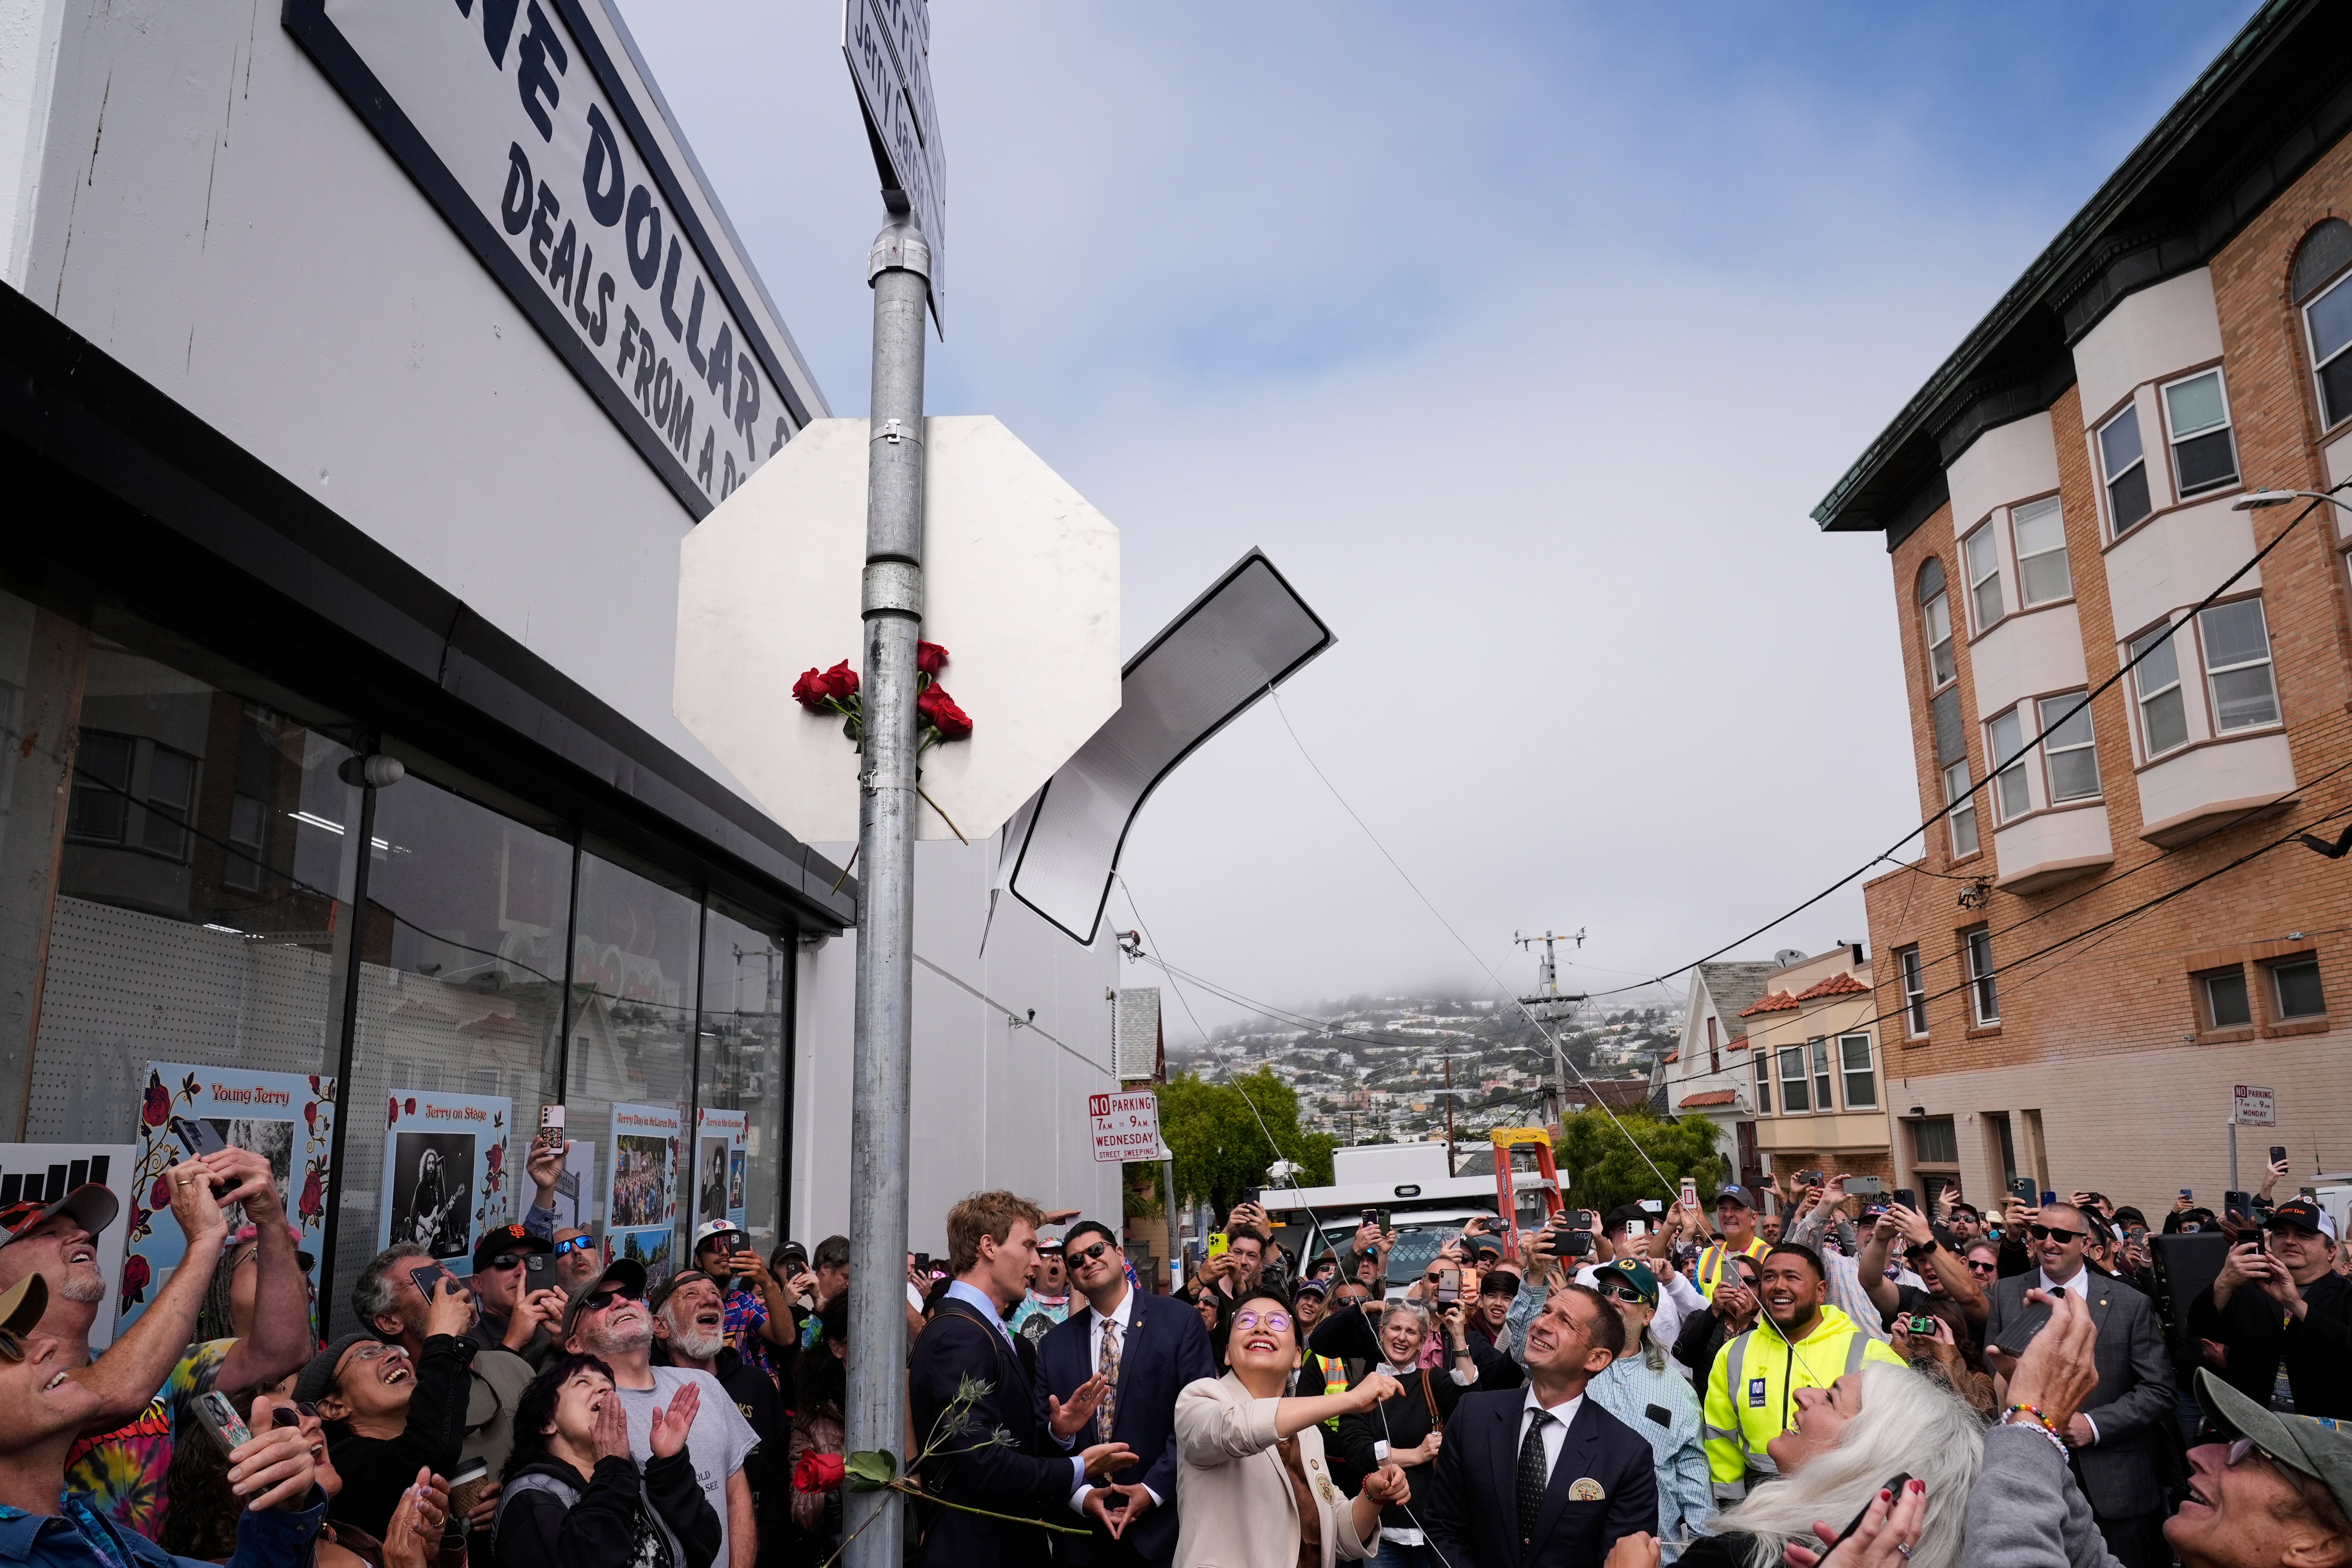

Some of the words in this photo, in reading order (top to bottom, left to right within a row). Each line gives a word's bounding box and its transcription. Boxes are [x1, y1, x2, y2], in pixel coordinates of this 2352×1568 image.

[855, 0, 891, 128] Jerry
[895, 89, 924, 218] Garcia
[583, 103, 760, 462] DOLLAR
[501, 141, 615, 347] DEALS
[617, 304, 693, 463] FROM
[698, 425, 714, 495] A
[721, 450, 746, 502] D
[212, 1083, 252, 1106] Young
[255, 1086, 290, 1108] Jerry
[2236, 1086, 2246, 1097] NO
[2248, 1090, 2272, 1099] PARKING
[426, 1104, 451, 1121] Jerry
[453, 1109, 462, 1120] on
[465, 1107, 486, 1122] Stage
[1091, 1097, 1109, 1115] NO
[1112, 1097, 1151, 1112] PARKING
[618, 1113, 633, 1125] Jerry
[634, 1114, 643, 1127] Day
[644, 1116, 648, 1126] in
[649, 1117, 667, 1127] McLaren
[668, 1118, 677, 1128] Park
[706, 1117, 717, 1128] Jerry
[1096, 1132, 1153, 1146] WEDNESDAY
[1124, 1148, 1154, 1157] SWEEPING
[705, 1481, 719, 1492] SEE
